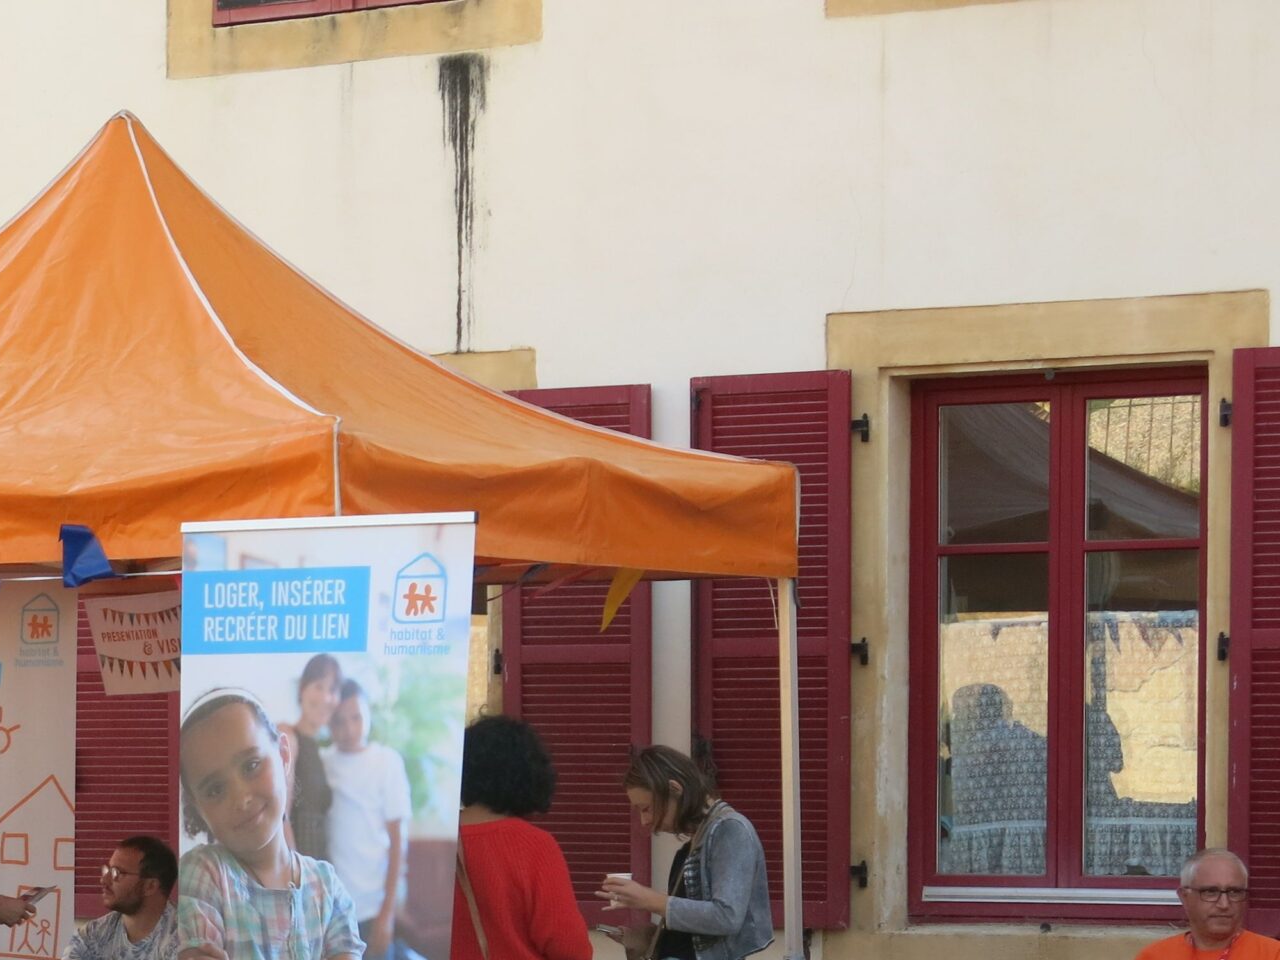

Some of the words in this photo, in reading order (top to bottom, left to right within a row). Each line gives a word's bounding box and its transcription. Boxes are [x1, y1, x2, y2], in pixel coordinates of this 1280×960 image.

[204, 580, 264, 610] LOGER,
[271, 577, 346, 607] INSÉRER
[204, 611, 278, 642] RECRÉER
[284, 615, 308, 640] DU
[312, 614, 350, 640] LIEN
[390, 627, 432, 641] habitat
[437, 628, 446, 640] &
[101, 629, 158, 642] PRESENTATION
[143, 641, 154, 656] &
[157, 638, 182, 654] VIS
[384, 642, 450, 656] humanisme
